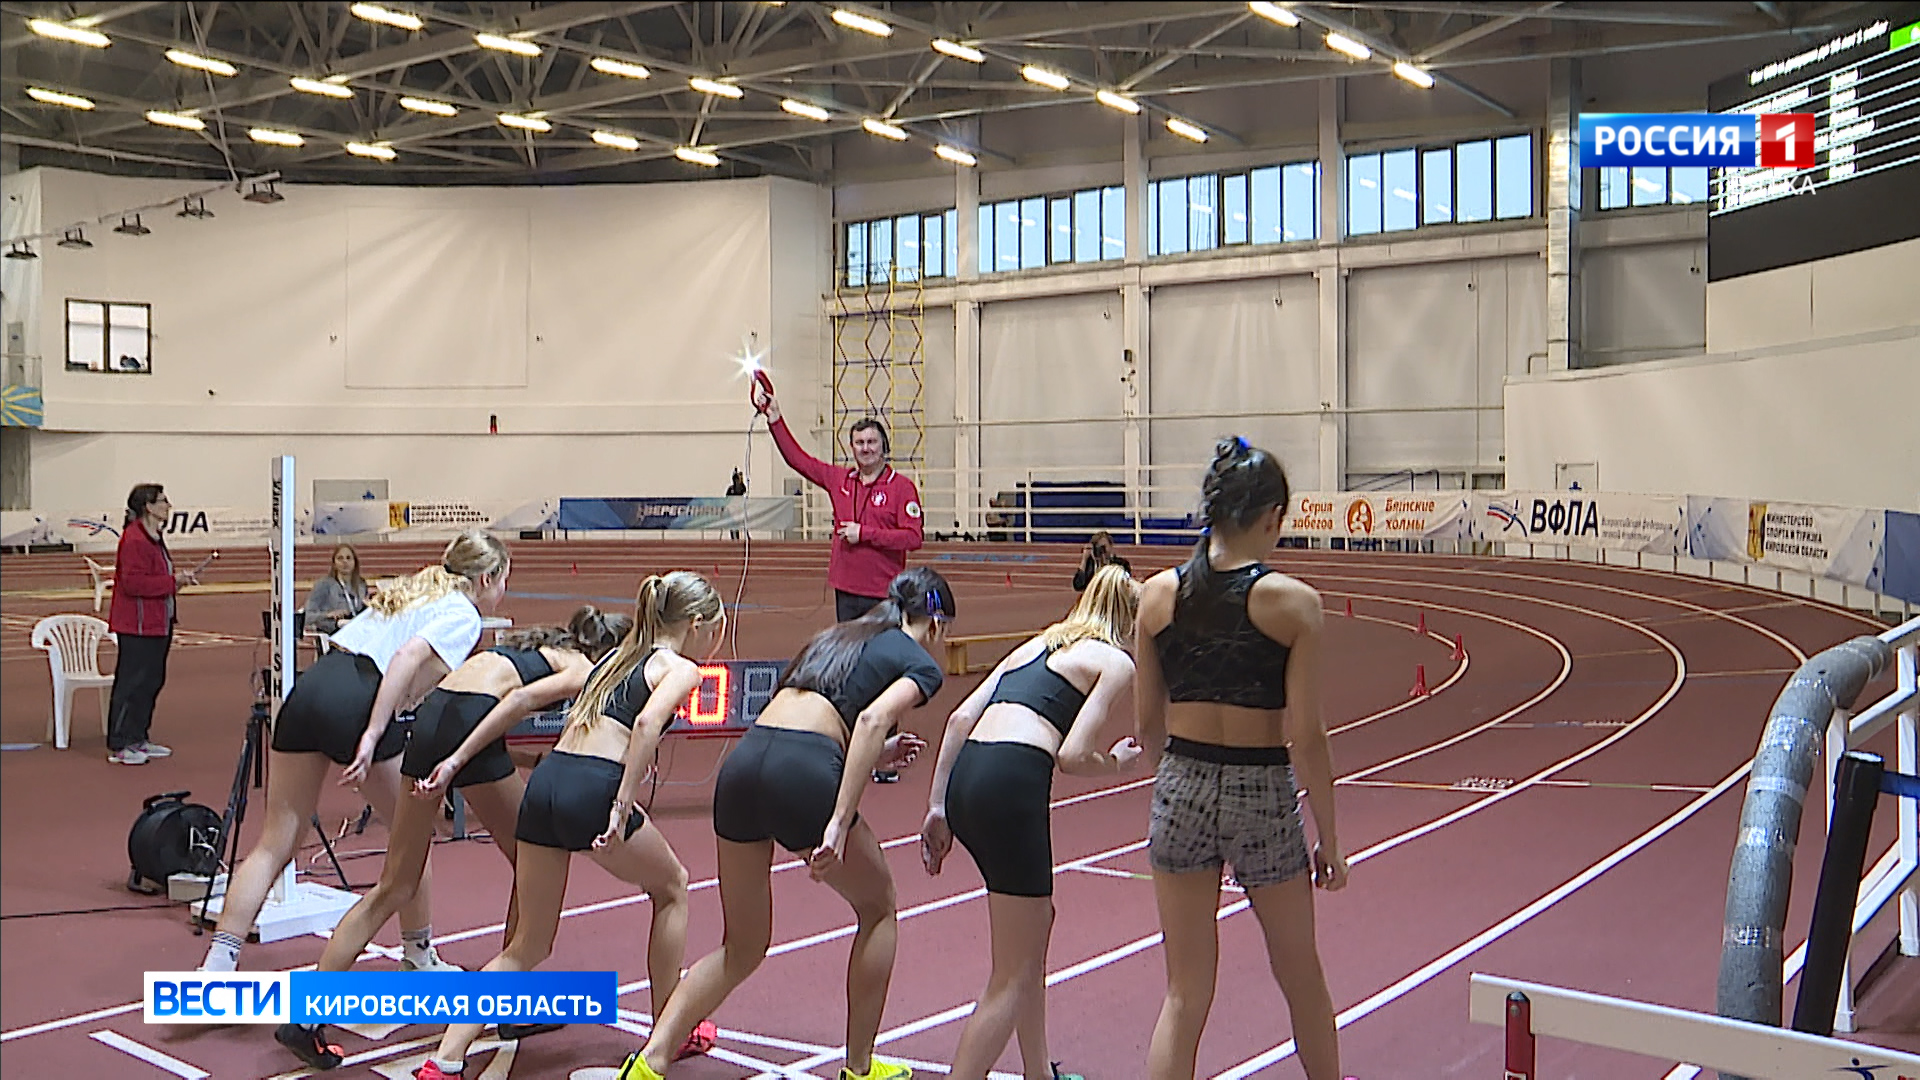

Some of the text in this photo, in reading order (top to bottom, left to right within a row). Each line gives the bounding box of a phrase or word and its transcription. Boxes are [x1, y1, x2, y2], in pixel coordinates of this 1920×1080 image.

[1301, 497, 1333, 515] Серия
[1292, 516, 1334, 530] забегов
[1385, 518, 1425, 531] холмы
[1530, 499, 1599, 538] ВФЛА
[1766, 513, 1814, 527] МИНИСТЕРСТВО
[1766, 527, 1789, 539] СПОРТА
[1796, 531, 1823, 543] ТУРИЗМА
[1765, 541, 1829, 560] КИРОВСКОЙ ОБЛАСТИ
[273, 551, 282, 698] FINISH
